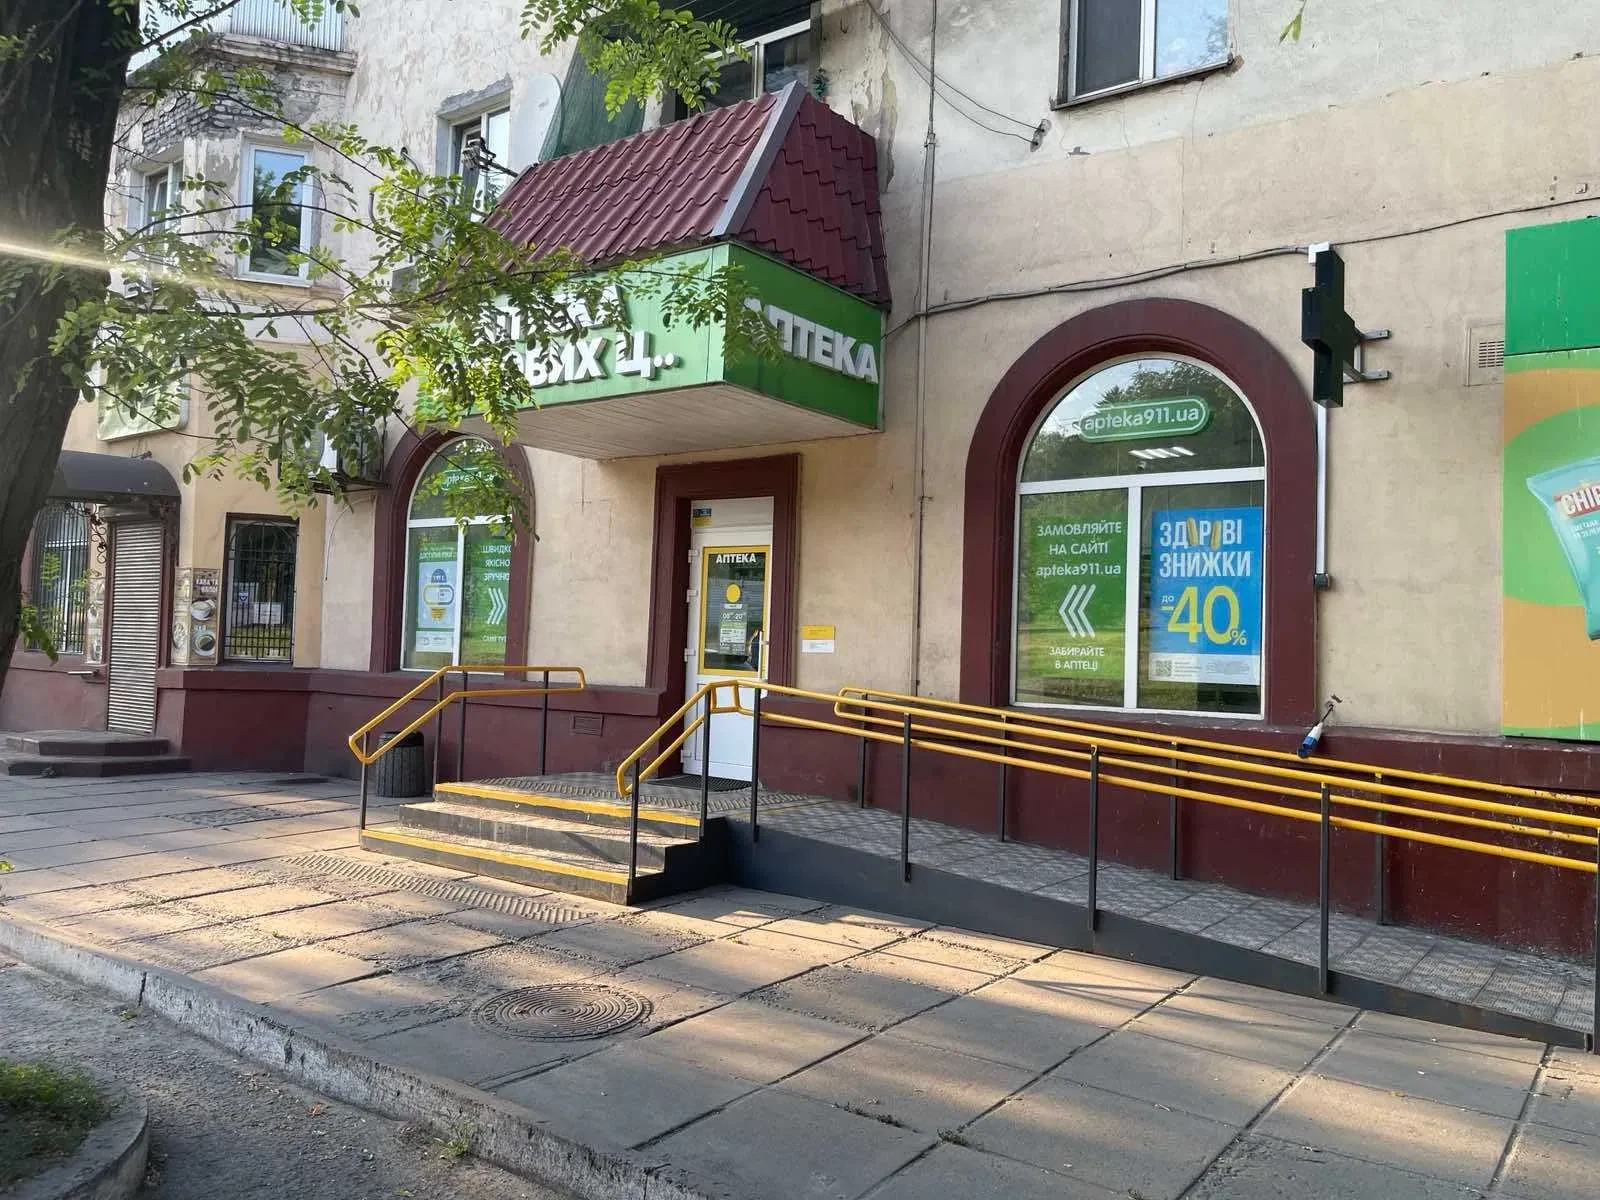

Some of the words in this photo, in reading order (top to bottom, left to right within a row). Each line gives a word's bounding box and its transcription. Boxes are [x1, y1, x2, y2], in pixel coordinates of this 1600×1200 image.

[1084, 406, 1200, 434] apteka911.ua
[1037, 520, 1122, 537] ЗАМОВЛЯЙТЕ
[1049, 543, 1067, 555] НА
[1070, 540, 1108, 555] САЙТІ
[715, 553, 757, 563] АПТЕКА
[1159, 551, 1252, 577] ЗНИЖКИ
[1036, 563, 1121, 579] apteka911.ua
[1049, 646, 1105, 657] ЗАБИРАЙТЕ
[1055, 660, 1062, 669] В
[1063, 660, 1098, 672] АПТЕЦІ
